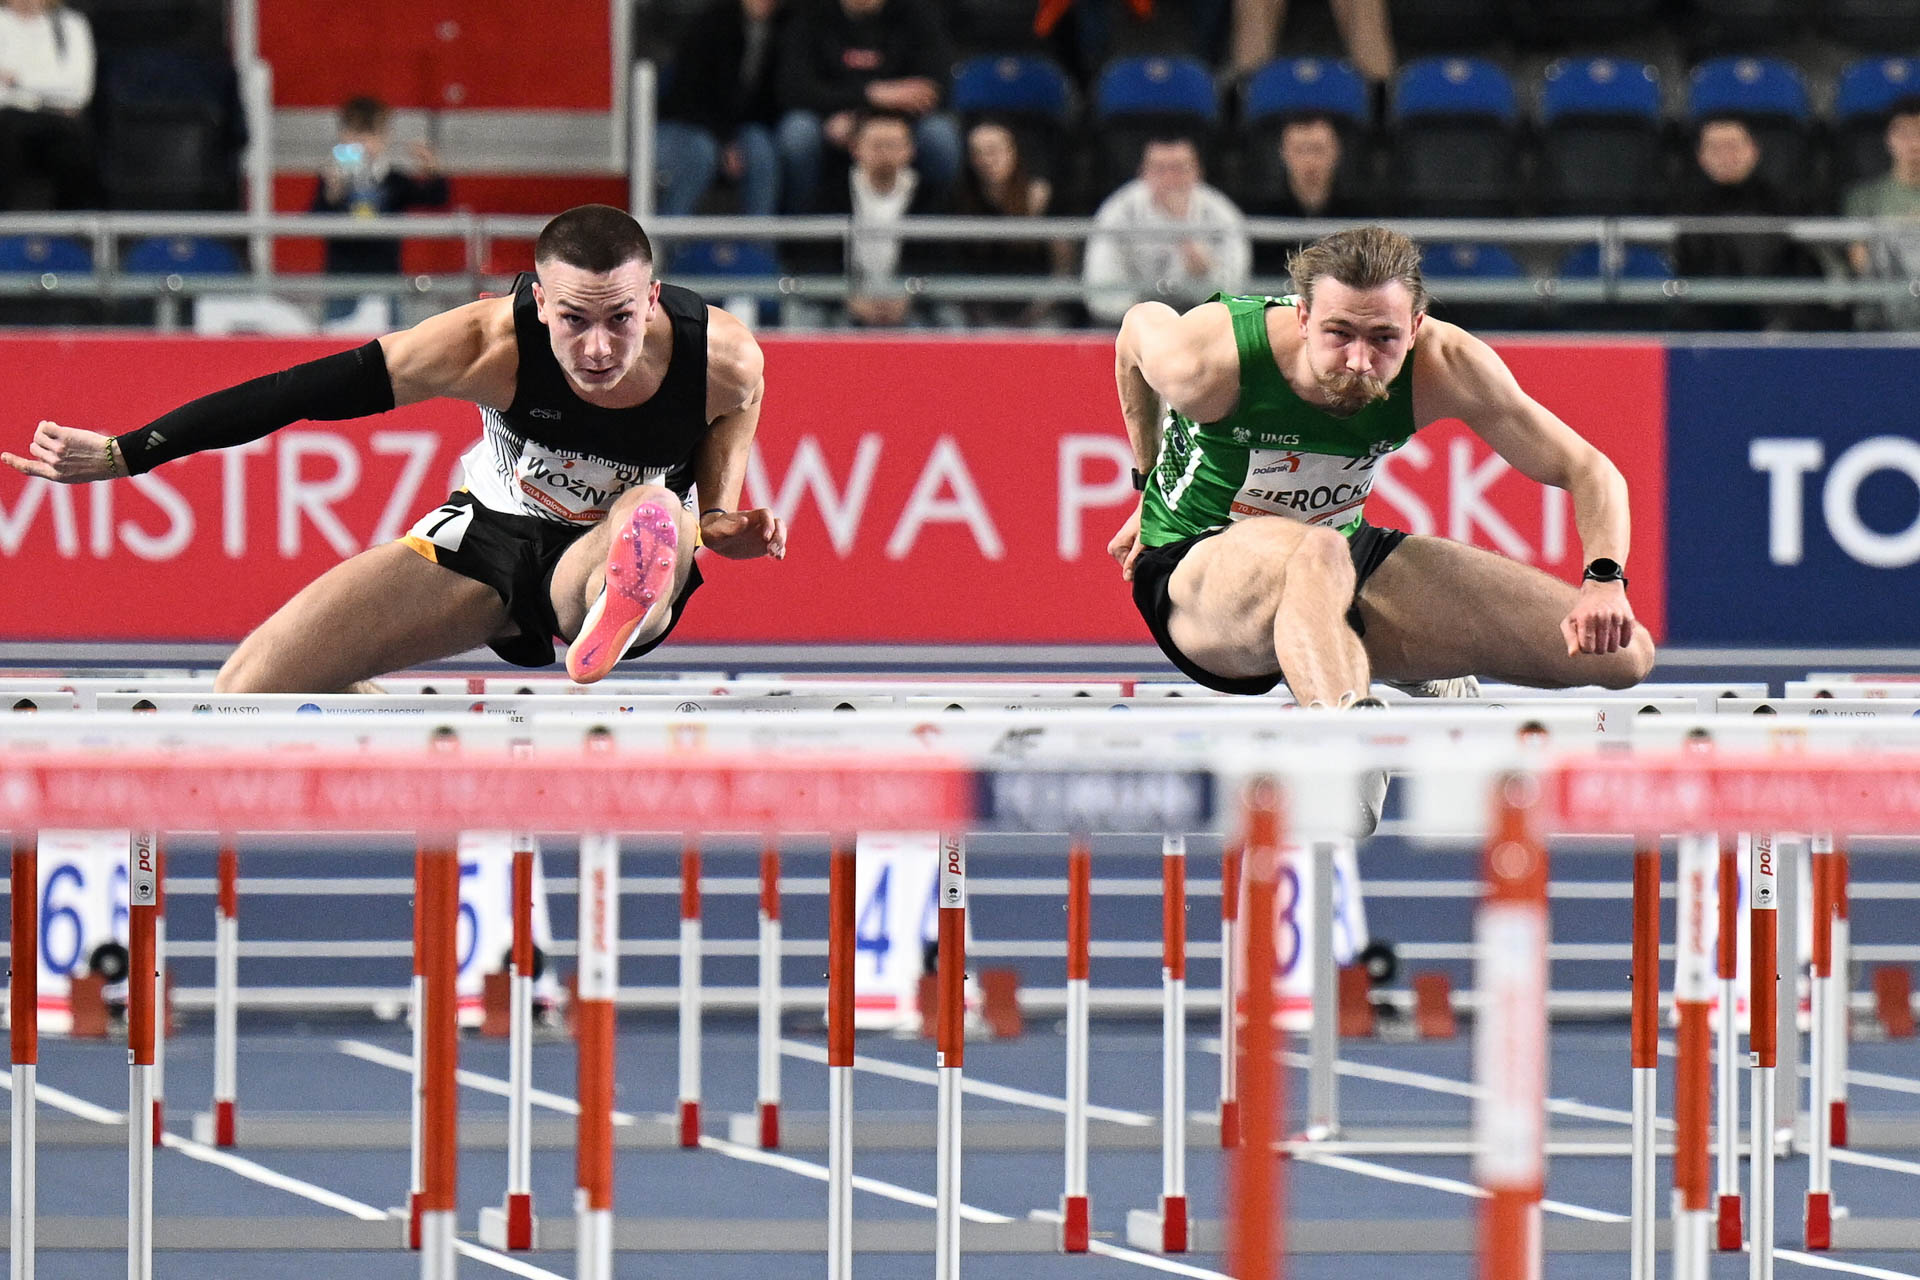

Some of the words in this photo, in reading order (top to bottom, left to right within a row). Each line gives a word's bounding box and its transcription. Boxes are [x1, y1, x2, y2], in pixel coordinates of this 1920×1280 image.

[1259, 432, 1300, 445] UMCS
[1252, 464, 1289, 476] polanik
[1057, 433, 1569, 565] PSKI
[1245, 474, 1375, 512] SIEROCKI
[426, 508, 465, 538] 7
[41, 864, 84, 975] 6
[855, 864, 890, 976] 4
